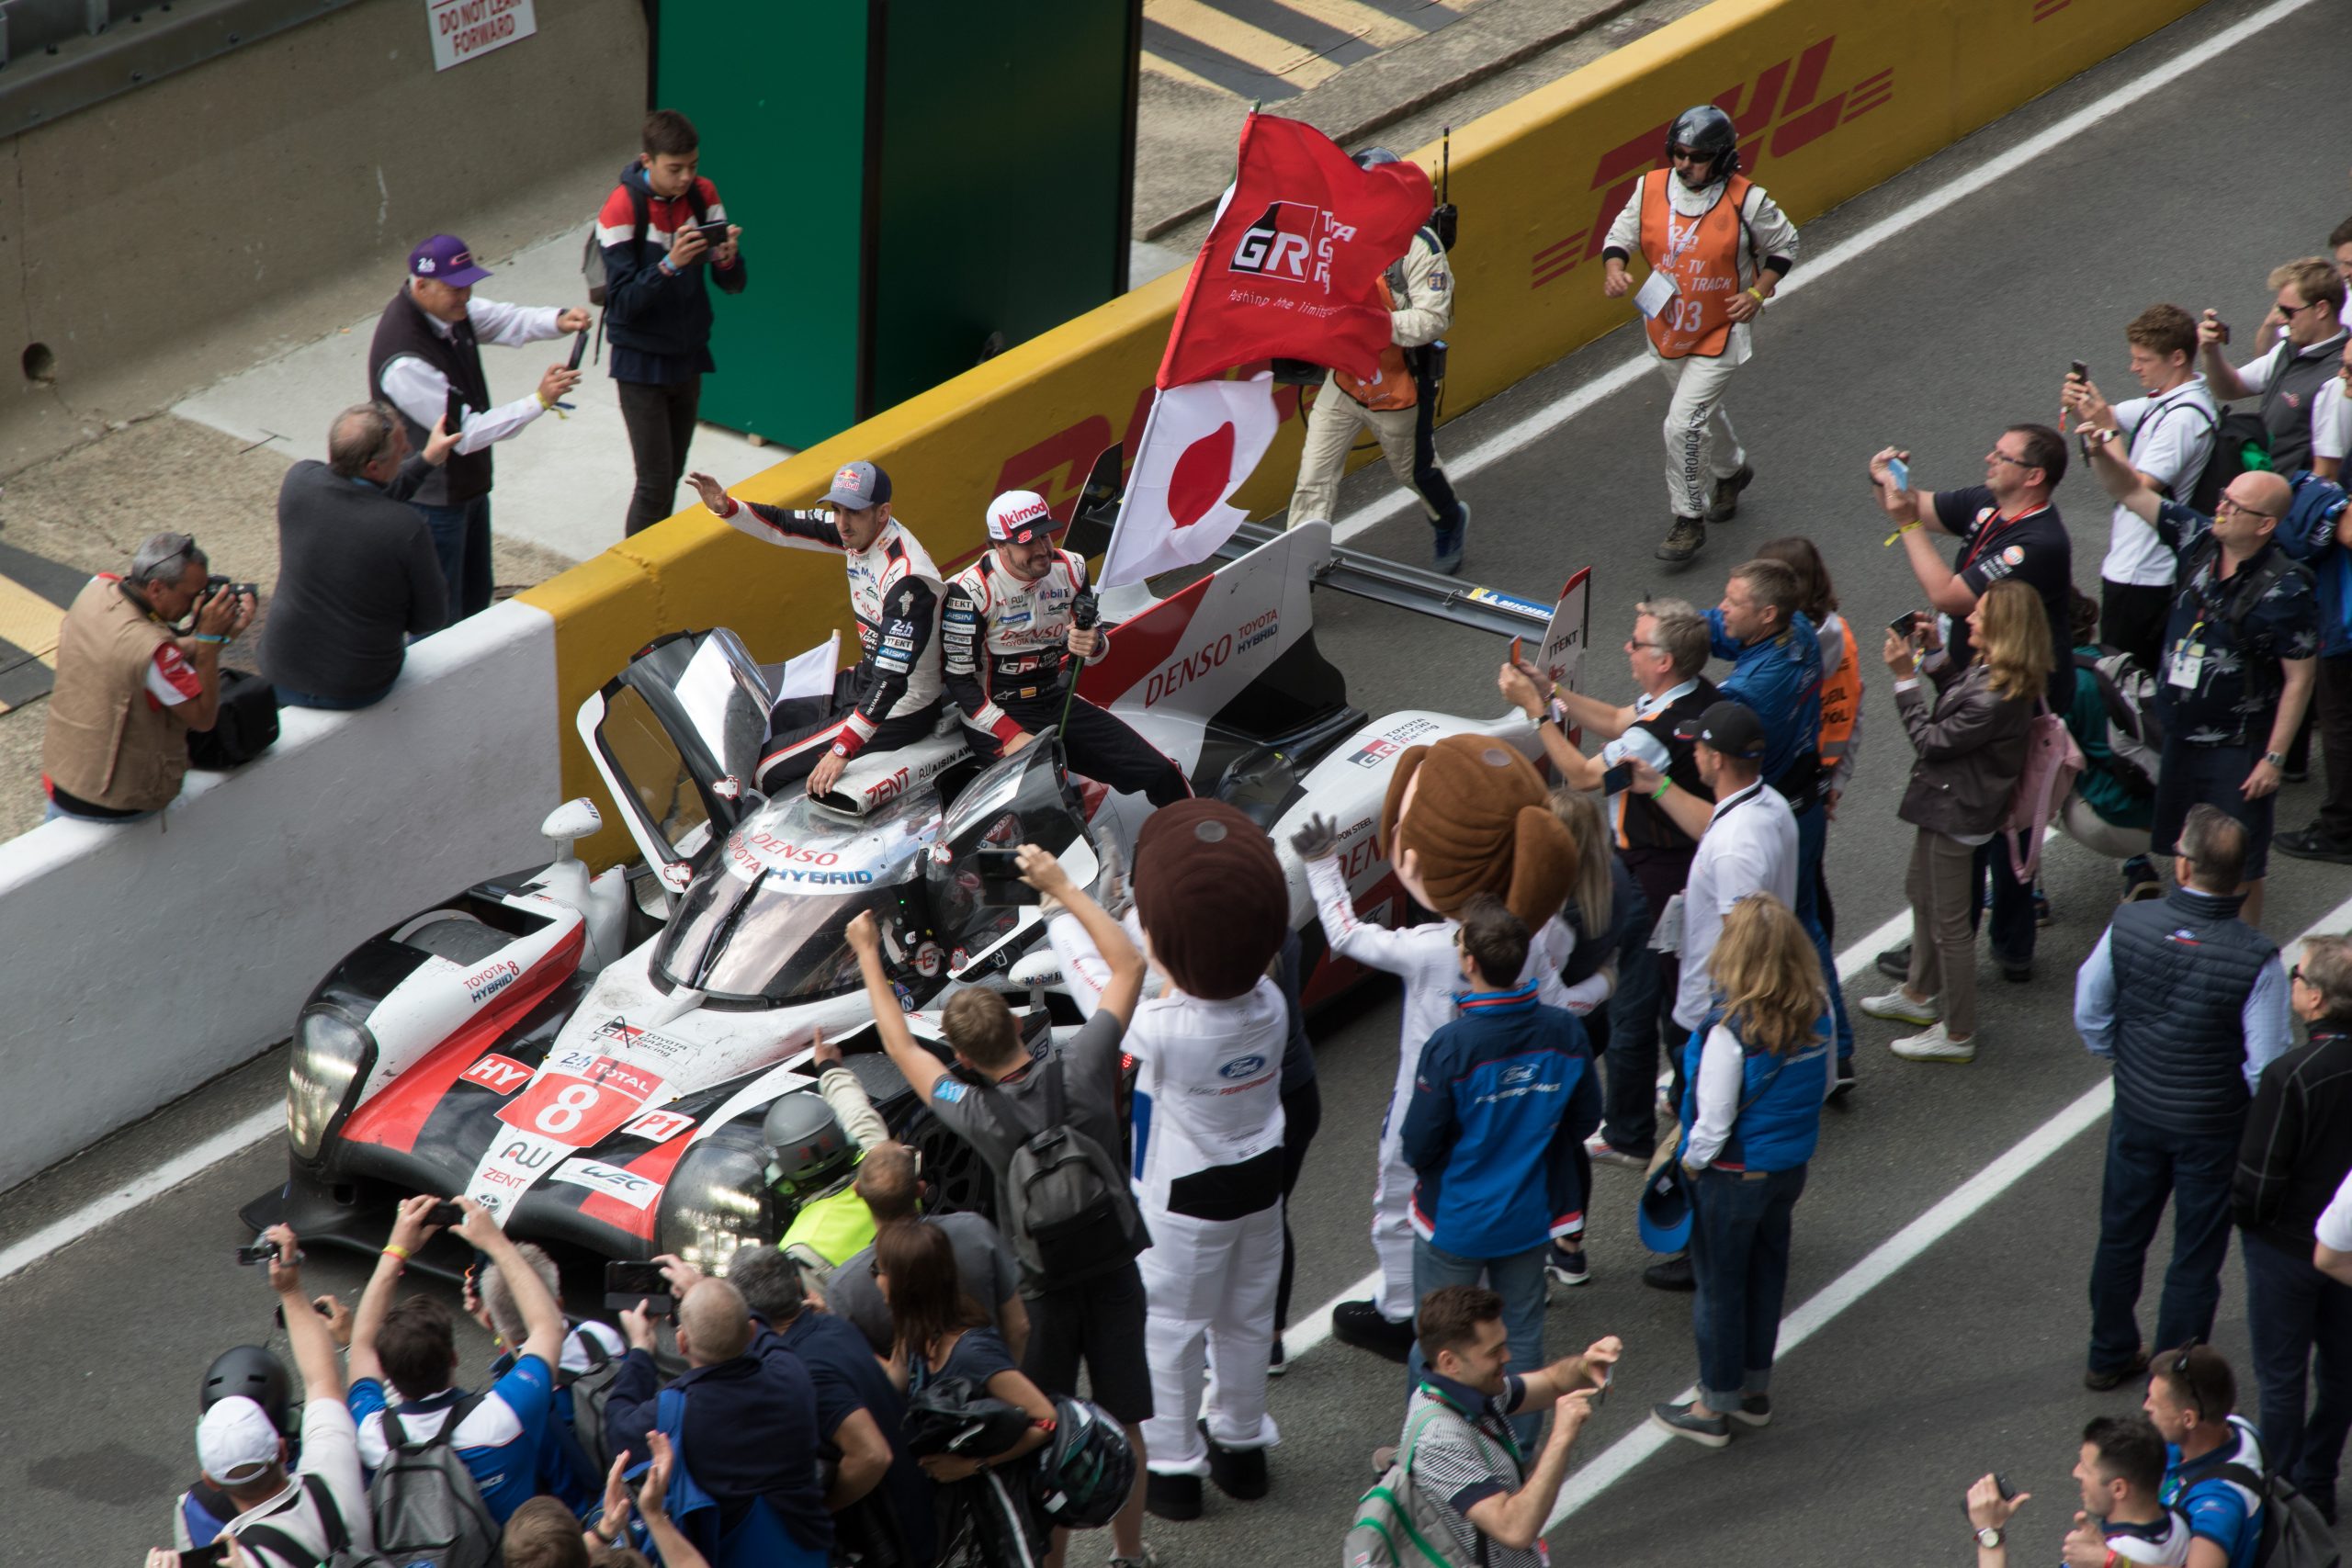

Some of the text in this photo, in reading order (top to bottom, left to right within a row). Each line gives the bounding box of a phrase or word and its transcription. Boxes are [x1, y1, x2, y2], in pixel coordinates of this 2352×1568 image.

[439, 8, 459, 36] DO
[459, 0, 487, 28] NOT
[452, 13, 515, 57] FORWARD
[1234, 227, 1310, 276] GR
[1689, 259, 1706, 274] TV
[1691, 277, 1733, 292] TRACK
[1227, 289, 1271, 308] Pushing
[1273, 296, 1295, 310] the
[1685, 401, 1710, 482] BROADCASTER
[1685, 484, 1702, 512] HOST
[946, 612, 972, 621] AISIN
[1238, 609, 1278, 639] TOYOTA
[1000, 623, 1064, 641] DENSO
[1001, 638, 1029, 647] TOYOTA
[1238, 624, 1278, 655] HYBRID
[882, 647, 910, 660] AISIN
[1145, 634, 1232, 709] DENSO
[865, 690, 883, 716] RICHARD
[1383, 717, 1425, 739] TOYOTA
[1393, 722, 1430, 741] GAZOO
[1400, 724, 1440, 744] Racing
[932, 753, 956, 773] AISIN
[1358, 743, 1396, 768] GR
[865, 766, 910, 807] ZENT
[1352, 817, 1373, 834] STEEL
[728, 829, 873, 885] TOYOTA HYBRID
[750, 832, 839, 866] DENSO
[463, 964, 507, 989] TOYOTA
[507, 961, 519, 976] 8
[471, 973, 514, 1003] HYBRID
[1025, 974, 1053, 987] Mobil
[903, 997, 912, 1010] N
[632, 1040, 671, 1057] Racing
[638, 1036, 678, 1053] GAZOO
[646, 1032, 688, 1051] TOYOTA
[469, 1059, 527, 1087] HY
[594, 1062, 650, 1093] TOTAL
[535, 1083, 600, 1134] 8
[632, 1114, 683, 1137] P1
[482, 1168, 528, 1190] ZENT
[581, 1166, 649, 1191] WEC
